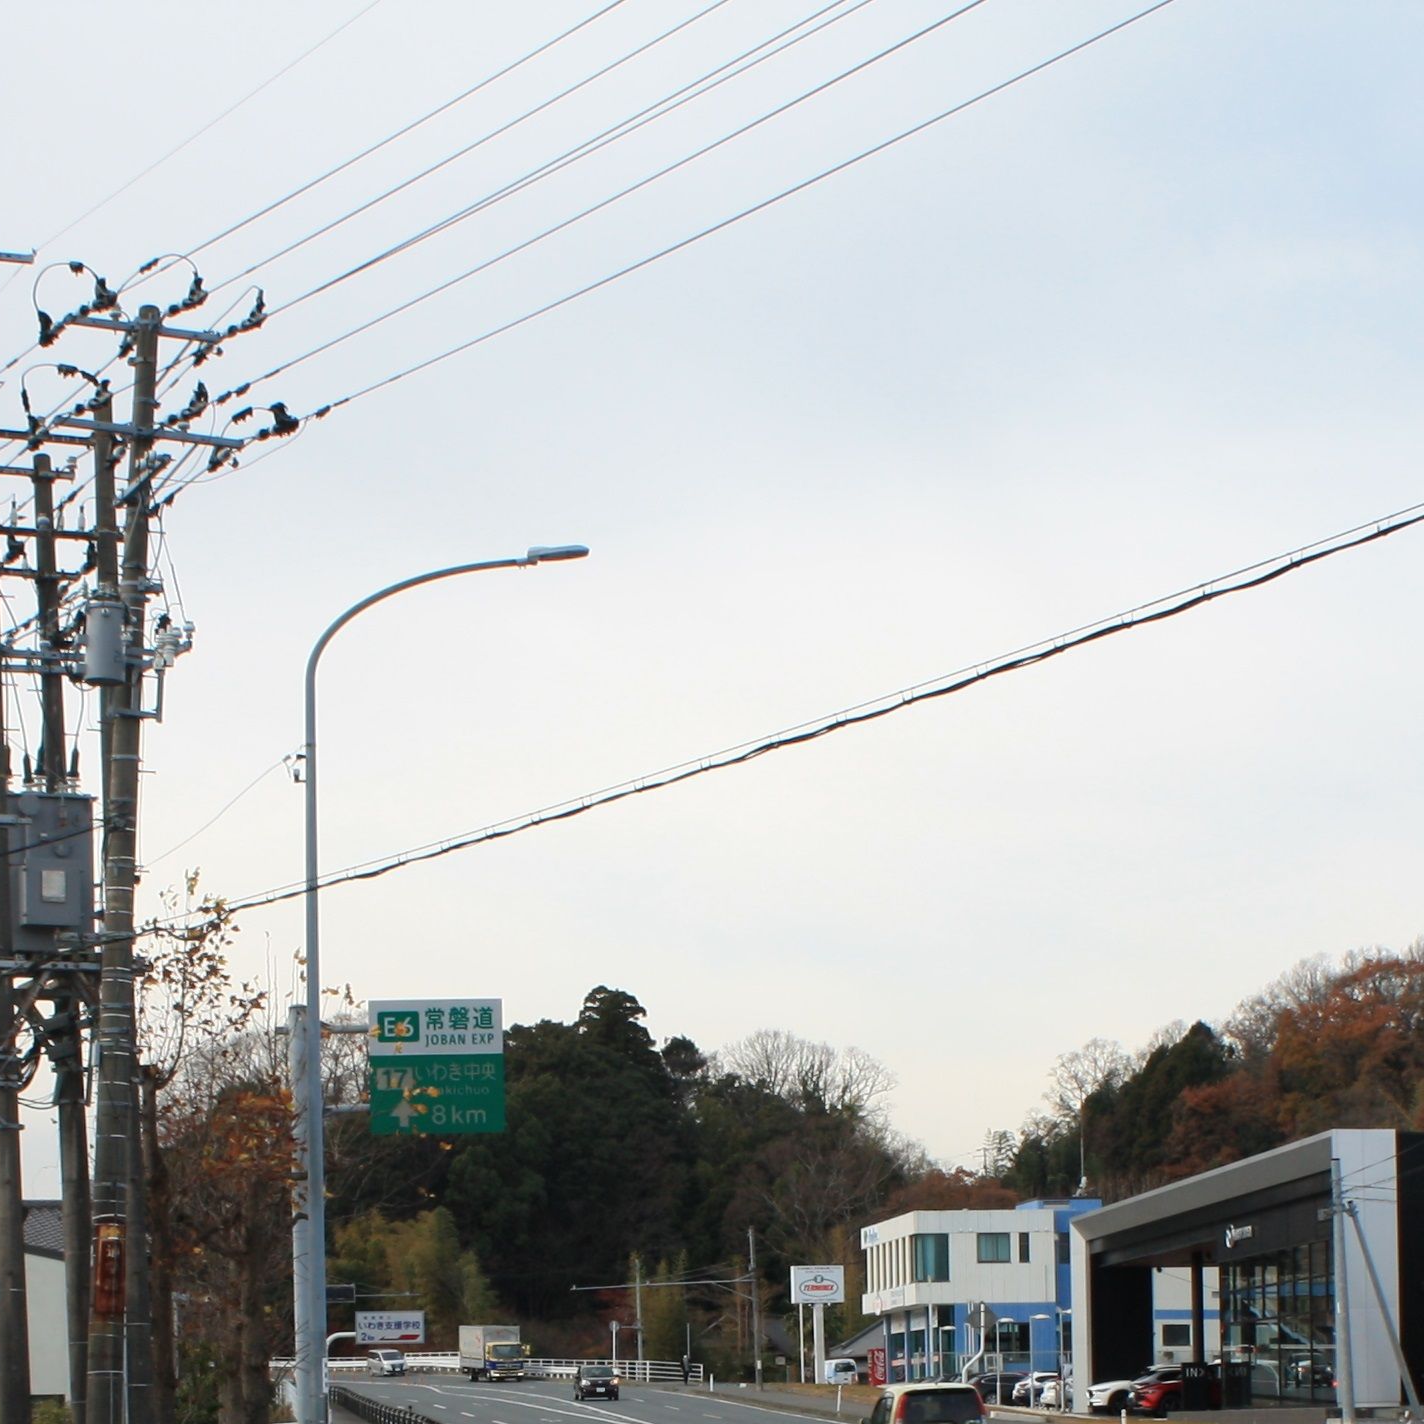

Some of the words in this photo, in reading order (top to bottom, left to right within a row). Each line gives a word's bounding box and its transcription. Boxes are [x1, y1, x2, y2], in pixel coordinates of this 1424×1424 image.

[384, 1017, 415, 1037] E6
[425, 1007, 495, 1031] 常磐道
[425, 1035, 466, 1047] JOBAN
[472, 1034, 495, 1045] EXP
[382, 1070, 408, 1088] 17
[416, 1063, 496, 1081] いわき中央
